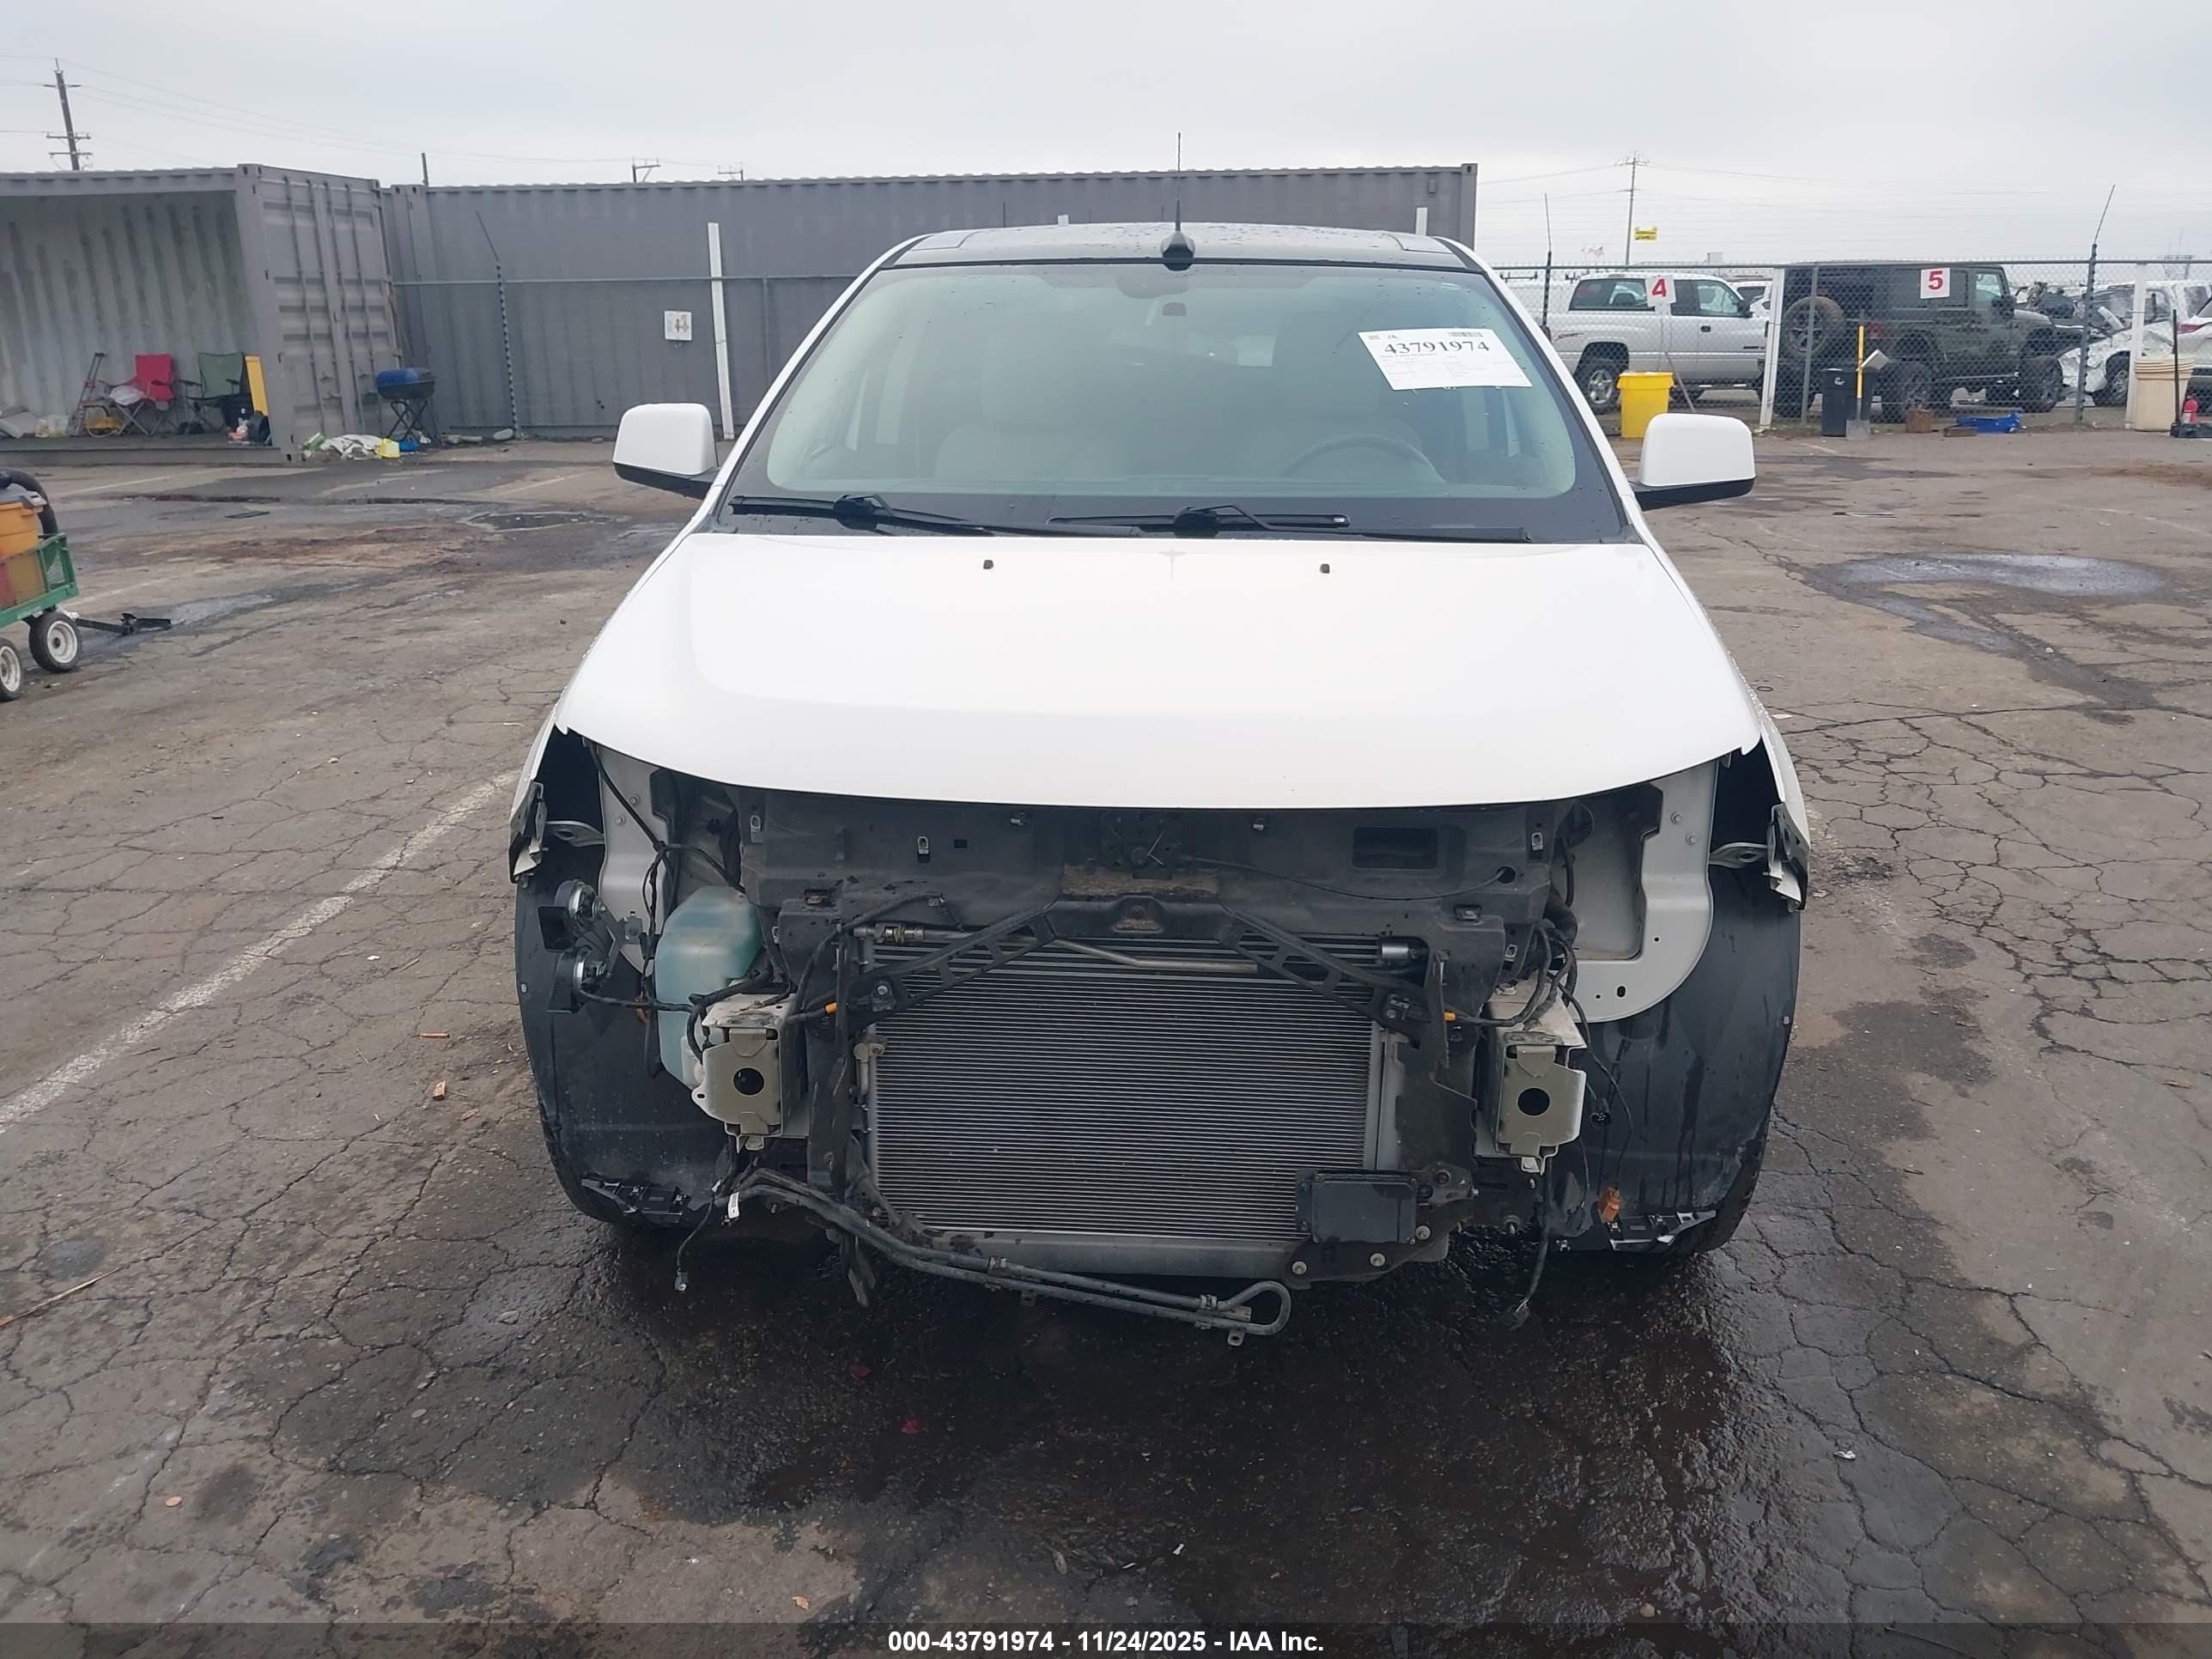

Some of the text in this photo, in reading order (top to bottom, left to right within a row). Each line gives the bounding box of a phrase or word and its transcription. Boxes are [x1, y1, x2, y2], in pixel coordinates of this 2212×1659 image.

[1651, 278, 1668, 297] 4
[1929, 270, 1943, 290] 5
[1384, 341, 1490, 354] 43791974
